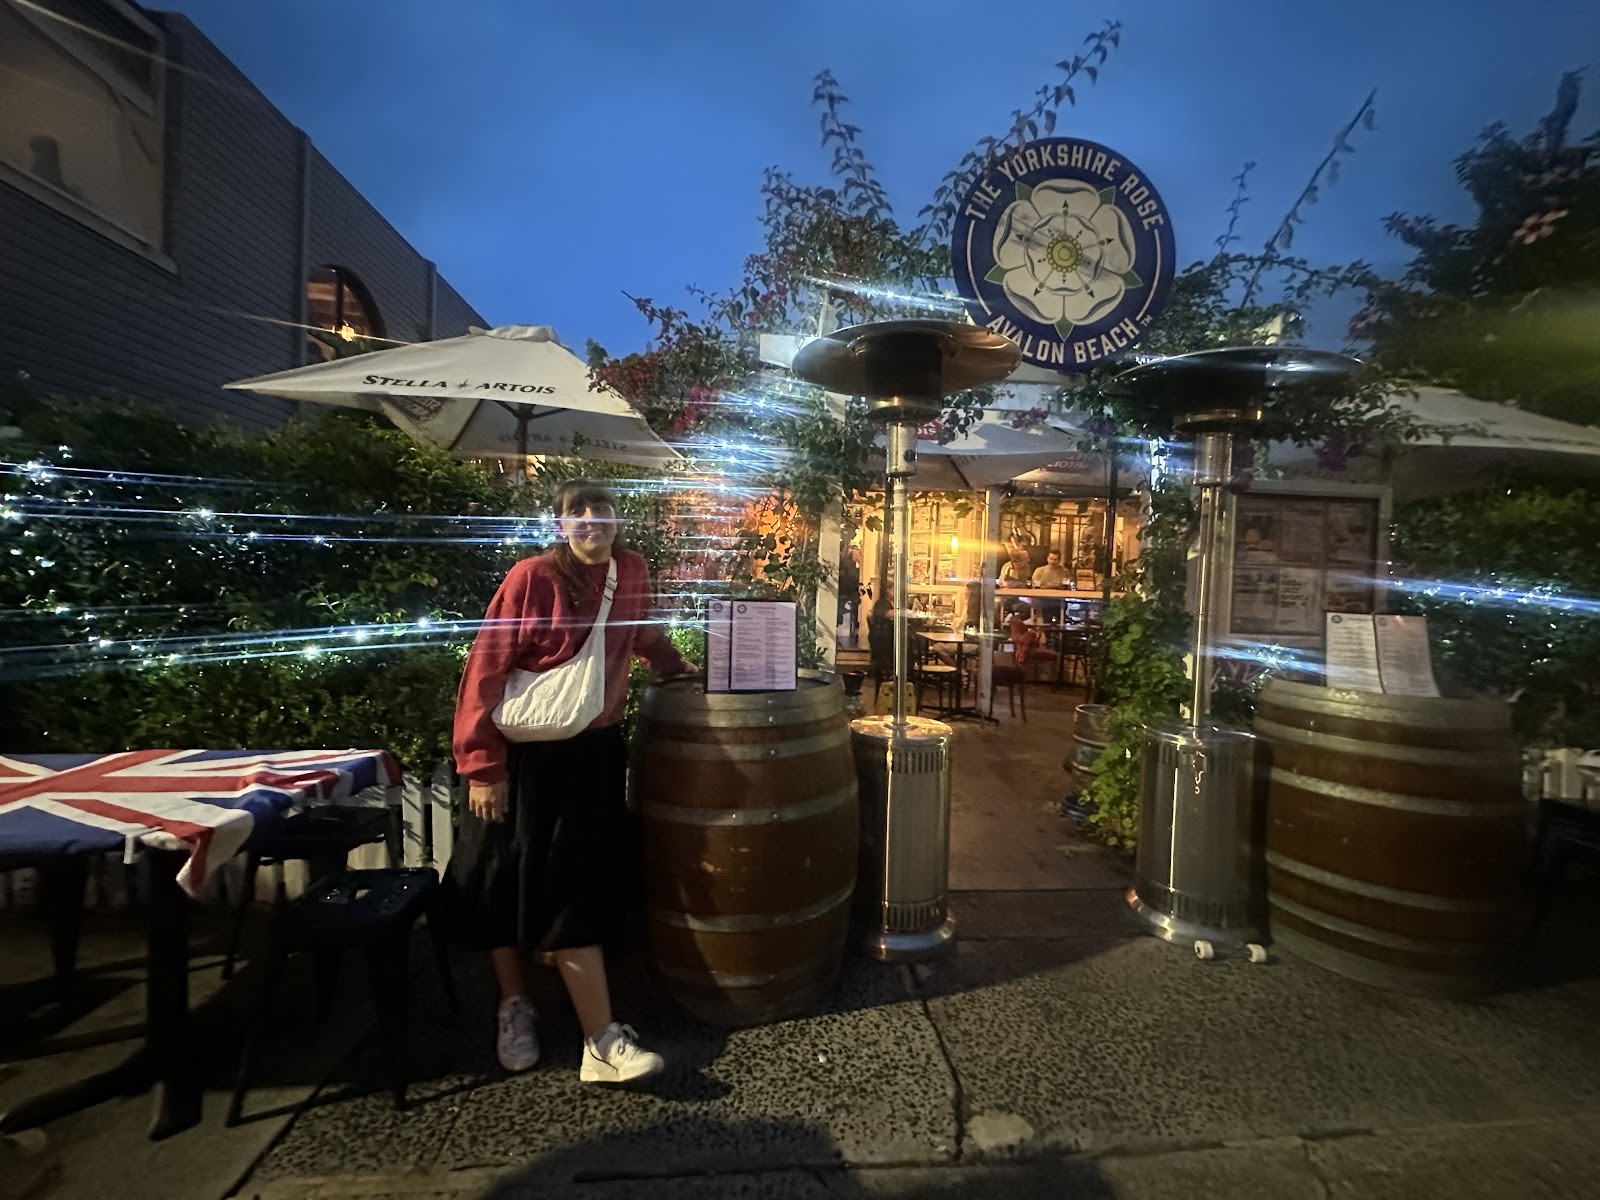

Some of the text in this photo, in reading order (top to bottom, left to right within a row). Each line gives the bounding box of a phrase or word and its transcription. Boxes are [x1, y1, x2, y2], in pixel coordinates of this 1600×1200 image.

[965, 144, 1165, 231] THE YORKSHIRE ROSE
[986, 314, 1065, 364] AVALON
[1074, 317, 1140, 363] BEACH
[363, 374, 556, 395] STELLA ARTOIS
